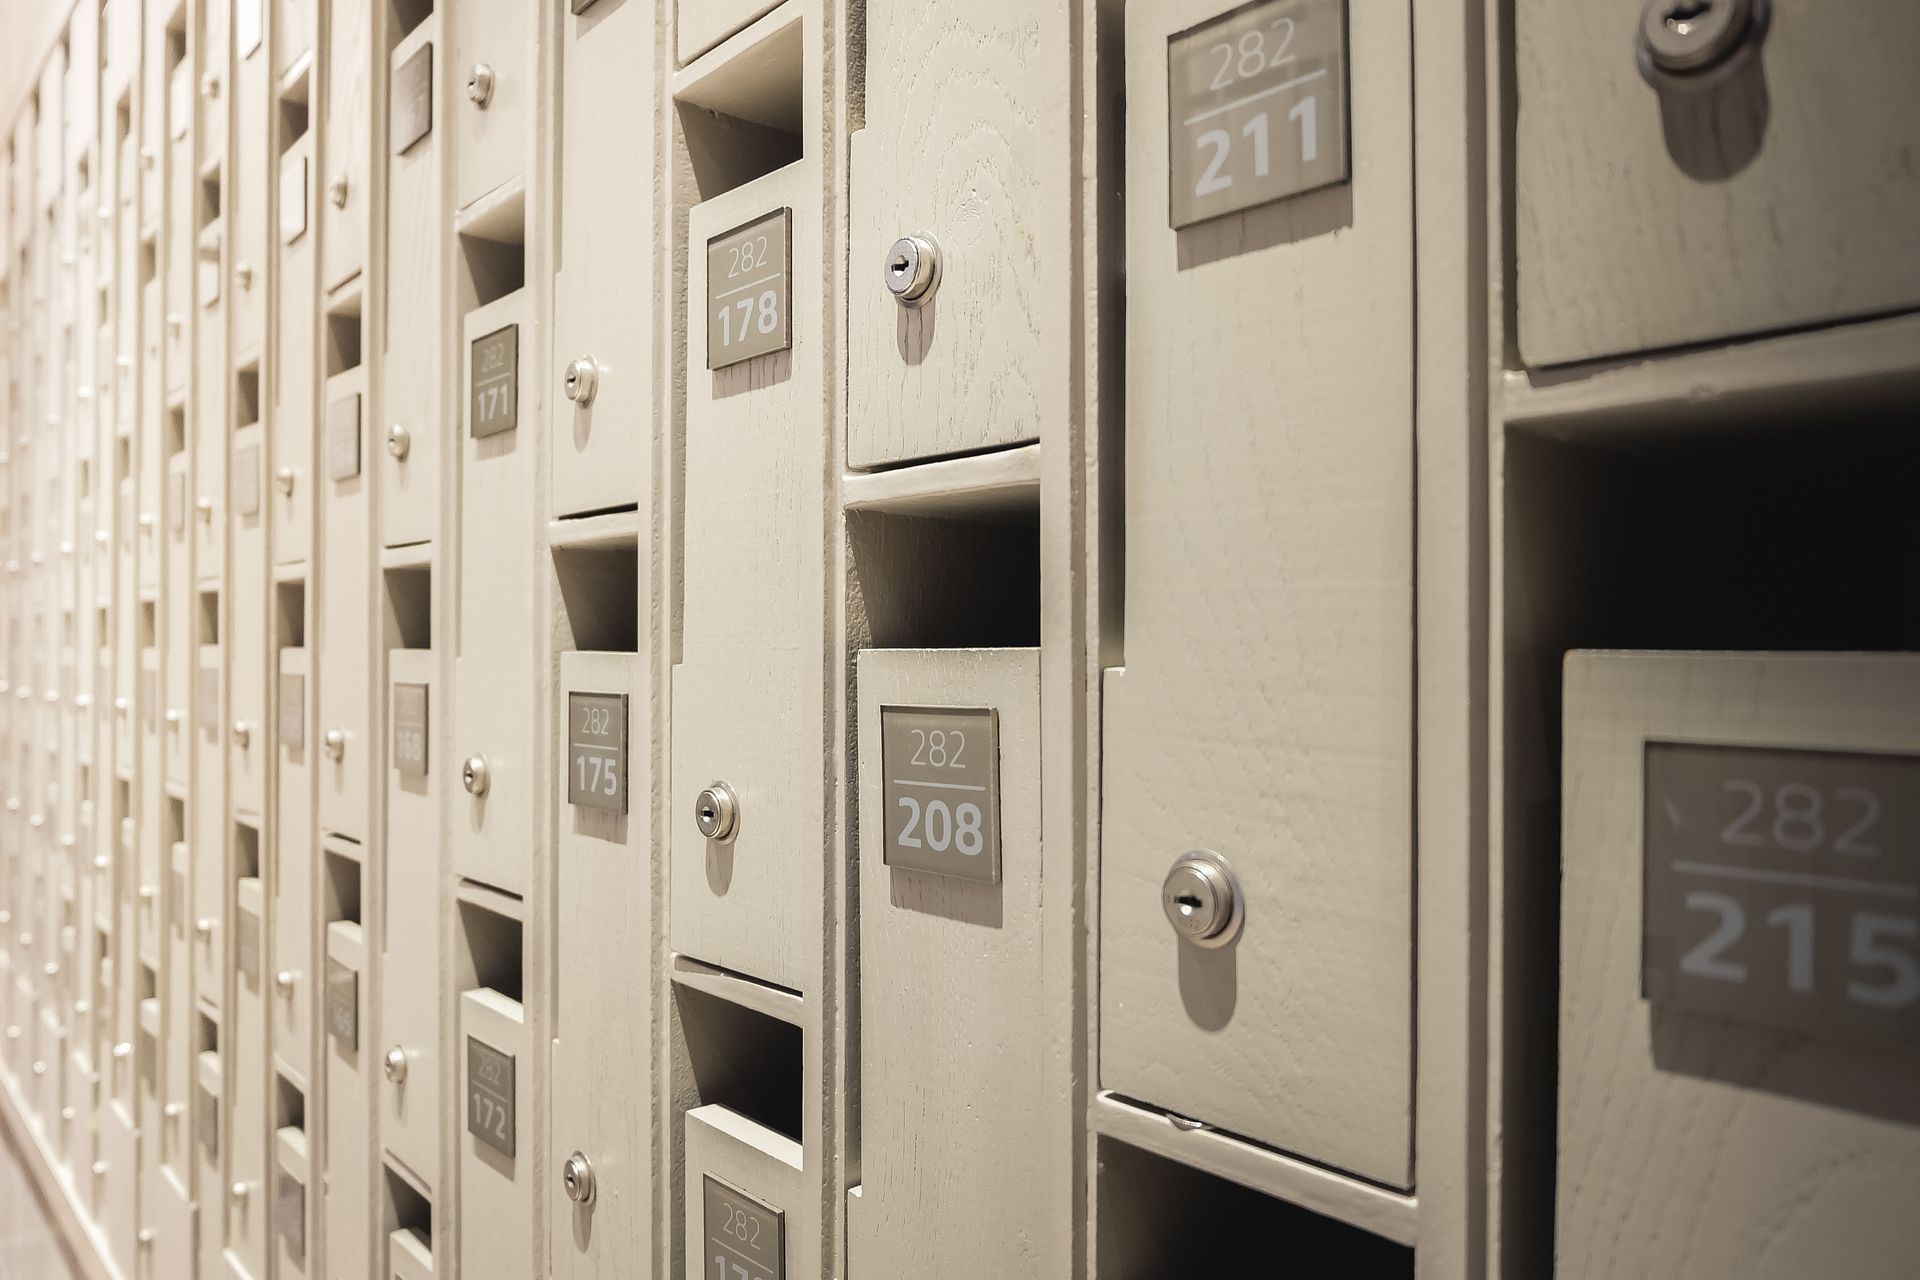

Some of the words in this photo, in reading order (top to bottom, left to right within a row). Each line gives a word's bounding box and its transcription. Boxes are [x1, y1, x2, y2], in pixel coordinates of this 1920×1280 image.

[1209, 17, 1295, 91] 282
[1196, 95, 1317, 197] 211
[728, 235, 768, 279] 282
[718, 290, 778, 346] 178
[478, 383, 508, 422] 171
[582, 707, 609, 735] 282
[911, 729, 966, 769] 282
[577, 755, 617, 796] 175
[897, 797, 983, 856] 208
[1721, 780, 1882, 858] 282
[1679, 891, 1920, 1008] 215
[474, 1092, 506, 1140] 172
[722, 1202, 761, 1250] 282
